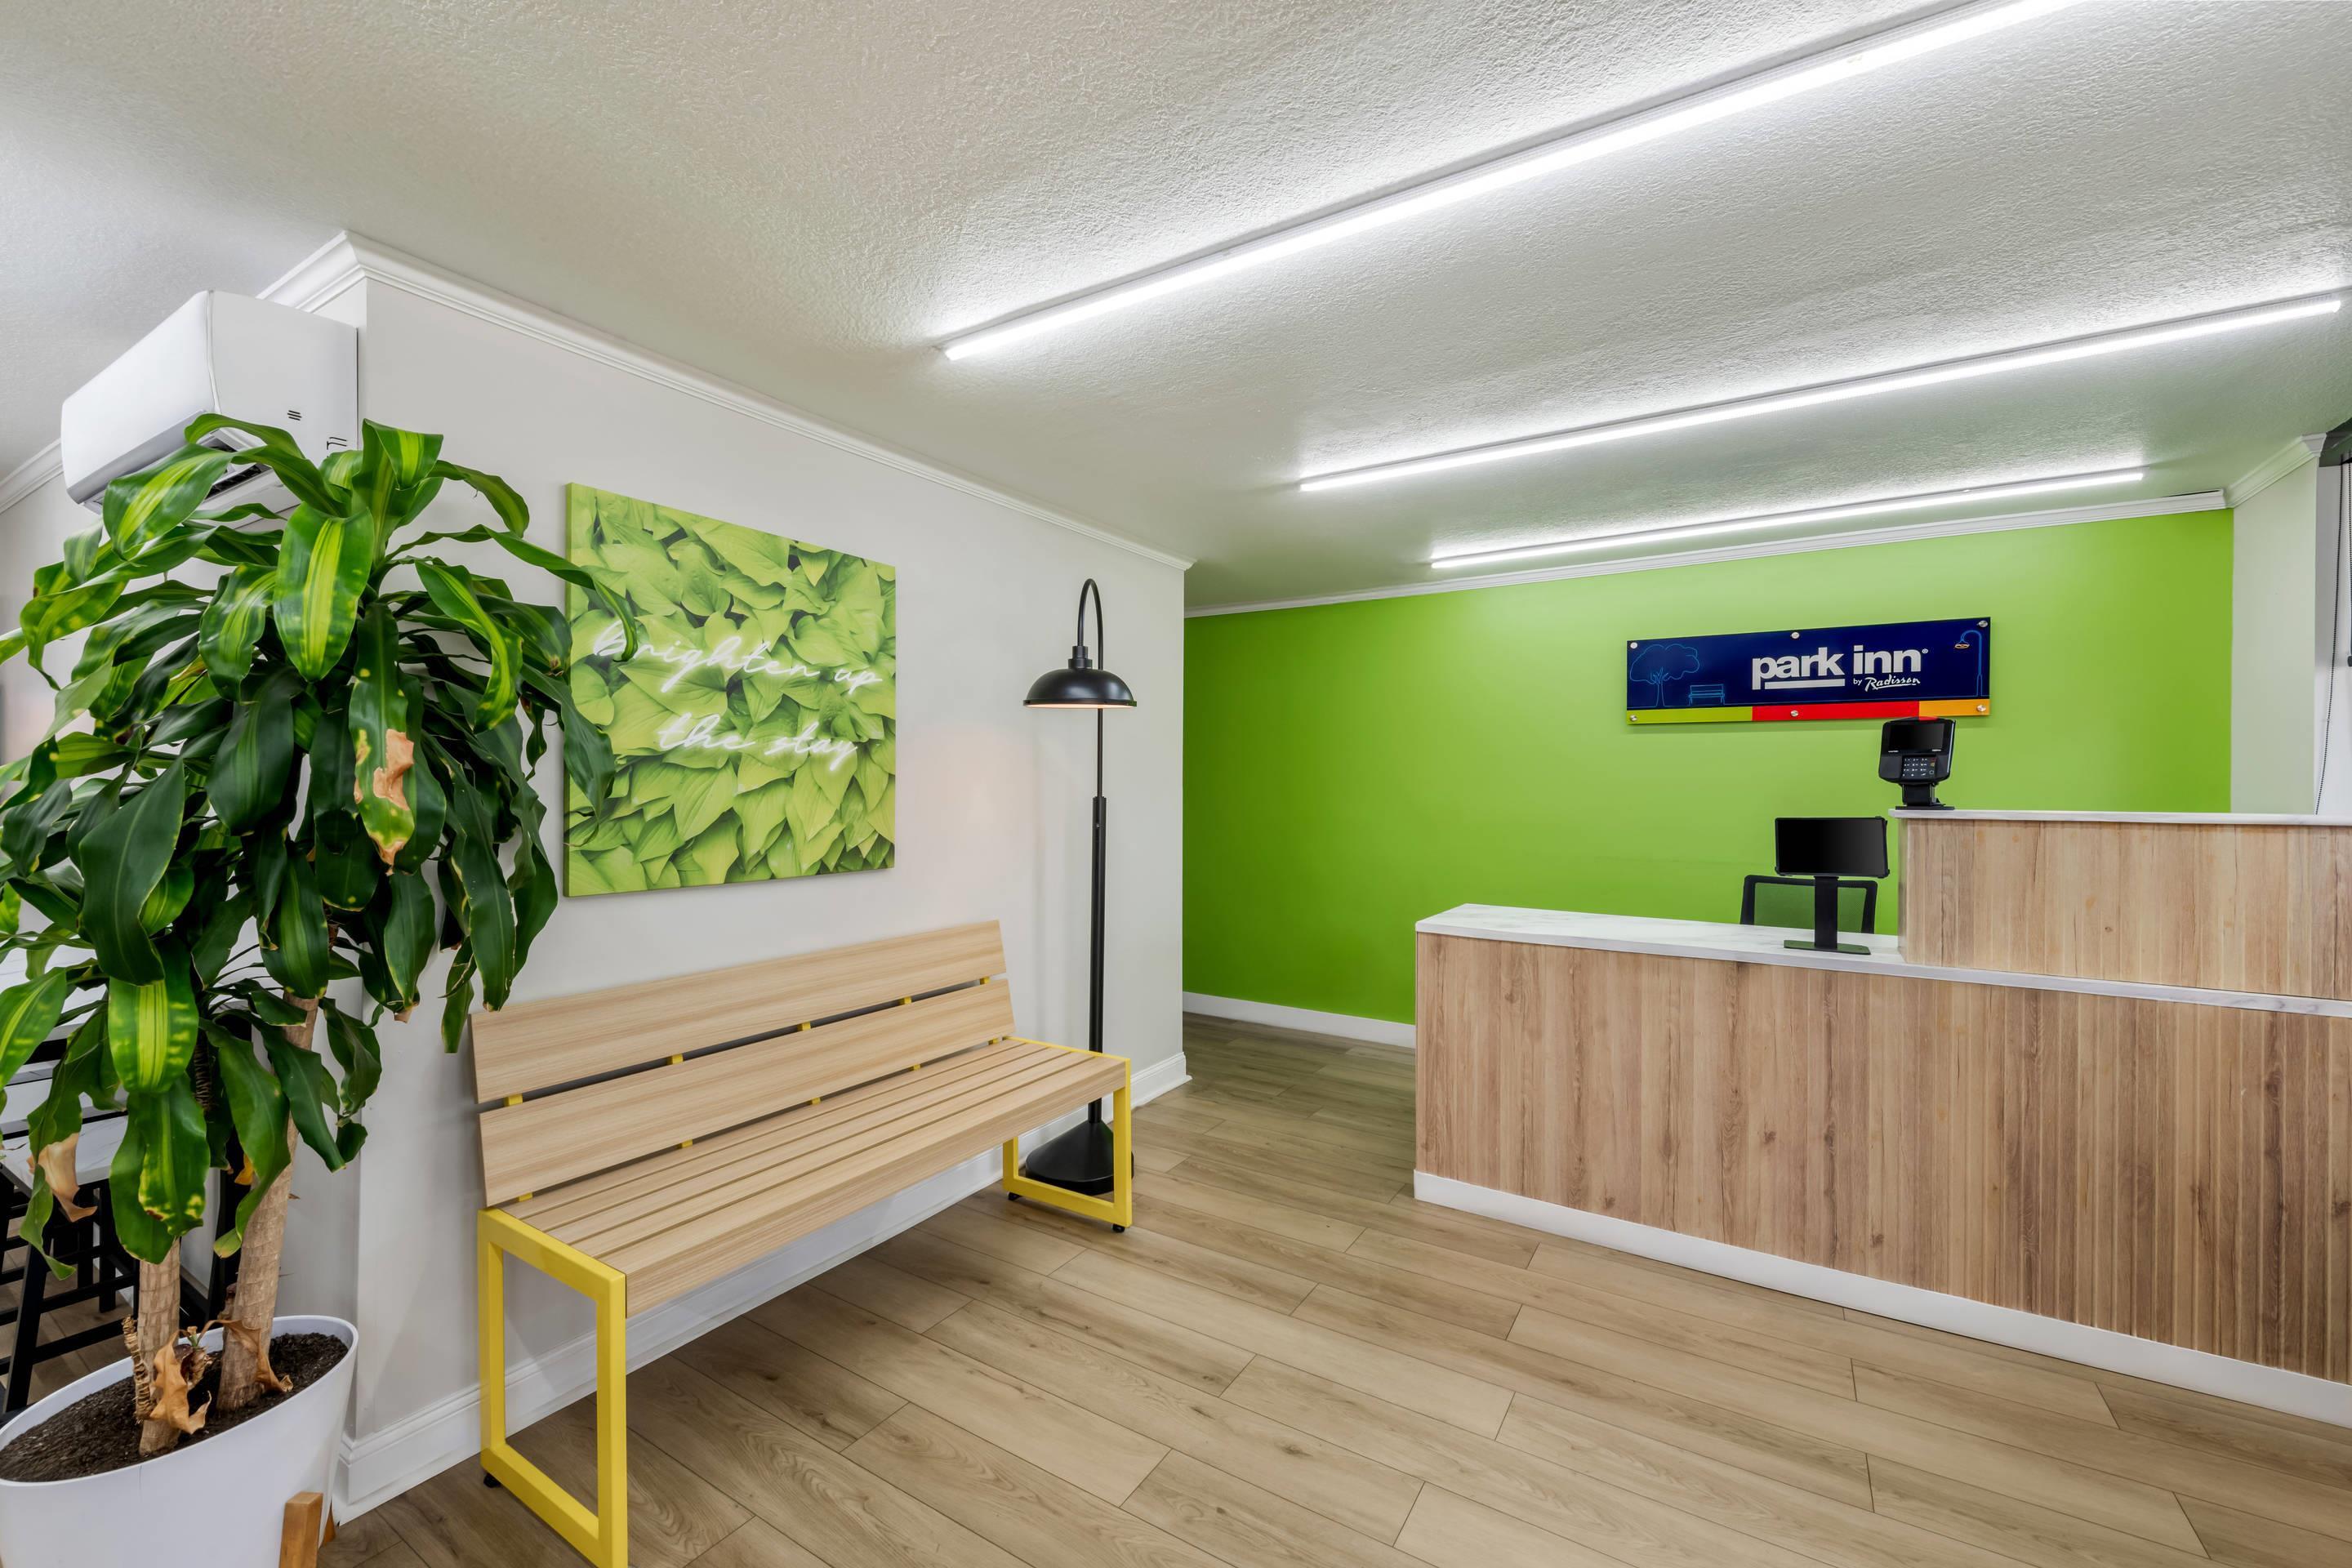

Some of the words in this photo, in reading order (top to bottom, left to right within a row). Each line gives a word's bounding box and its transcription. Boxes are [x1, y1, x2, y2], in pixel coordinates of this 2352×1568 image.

[593, 619, 821, 693] brighten
[834, 668, 883, 695] up
[1752, 647, 1846, 690] park
[1853, 678, 1863, 686] by
[1865, 675, 1921, 692] Radisson
[658, 713, 755, 751] the
[764, 721, 858, 771] stay
